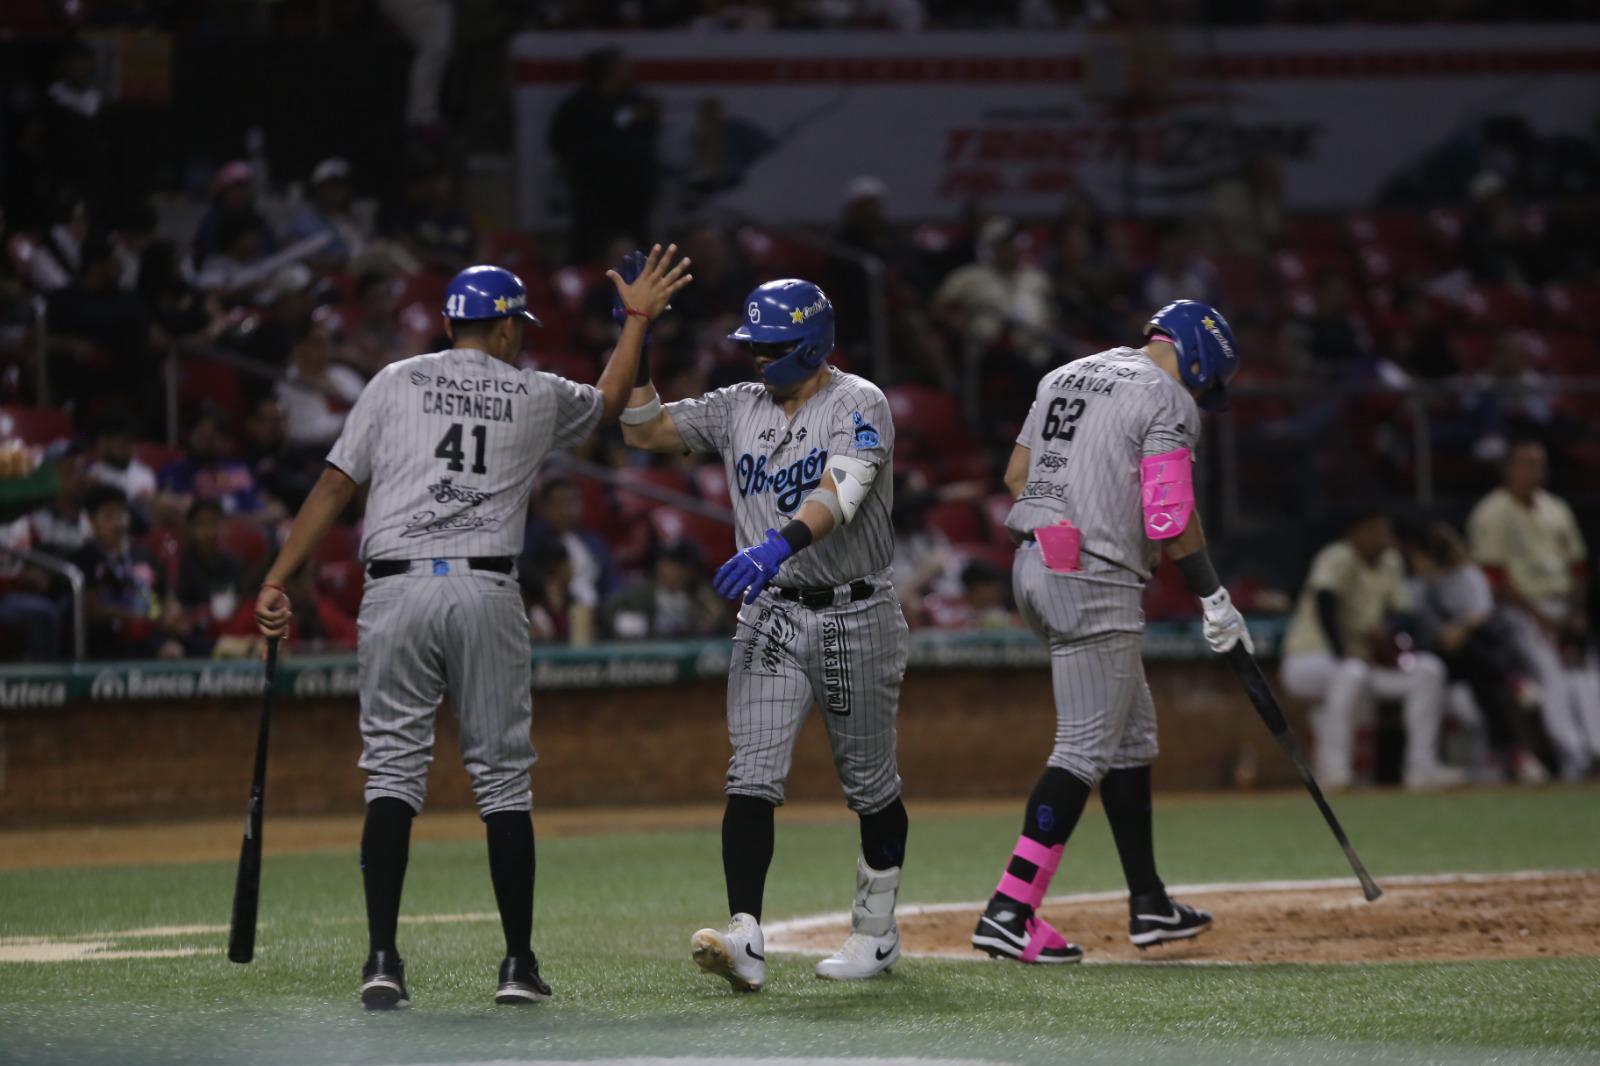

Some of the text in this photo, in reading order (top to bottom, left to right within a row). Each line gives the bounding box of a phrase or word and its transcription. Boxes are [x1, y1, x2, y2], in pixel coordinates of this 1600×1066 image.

[446, 294, 466, 317] 41
[436, 376, 529, 396] PACIFICA
[423, 390, 514, 423] CASTAÑEDA
[1041, 397, 1087, 442] 62
[434, 423, 488, 475] 41
